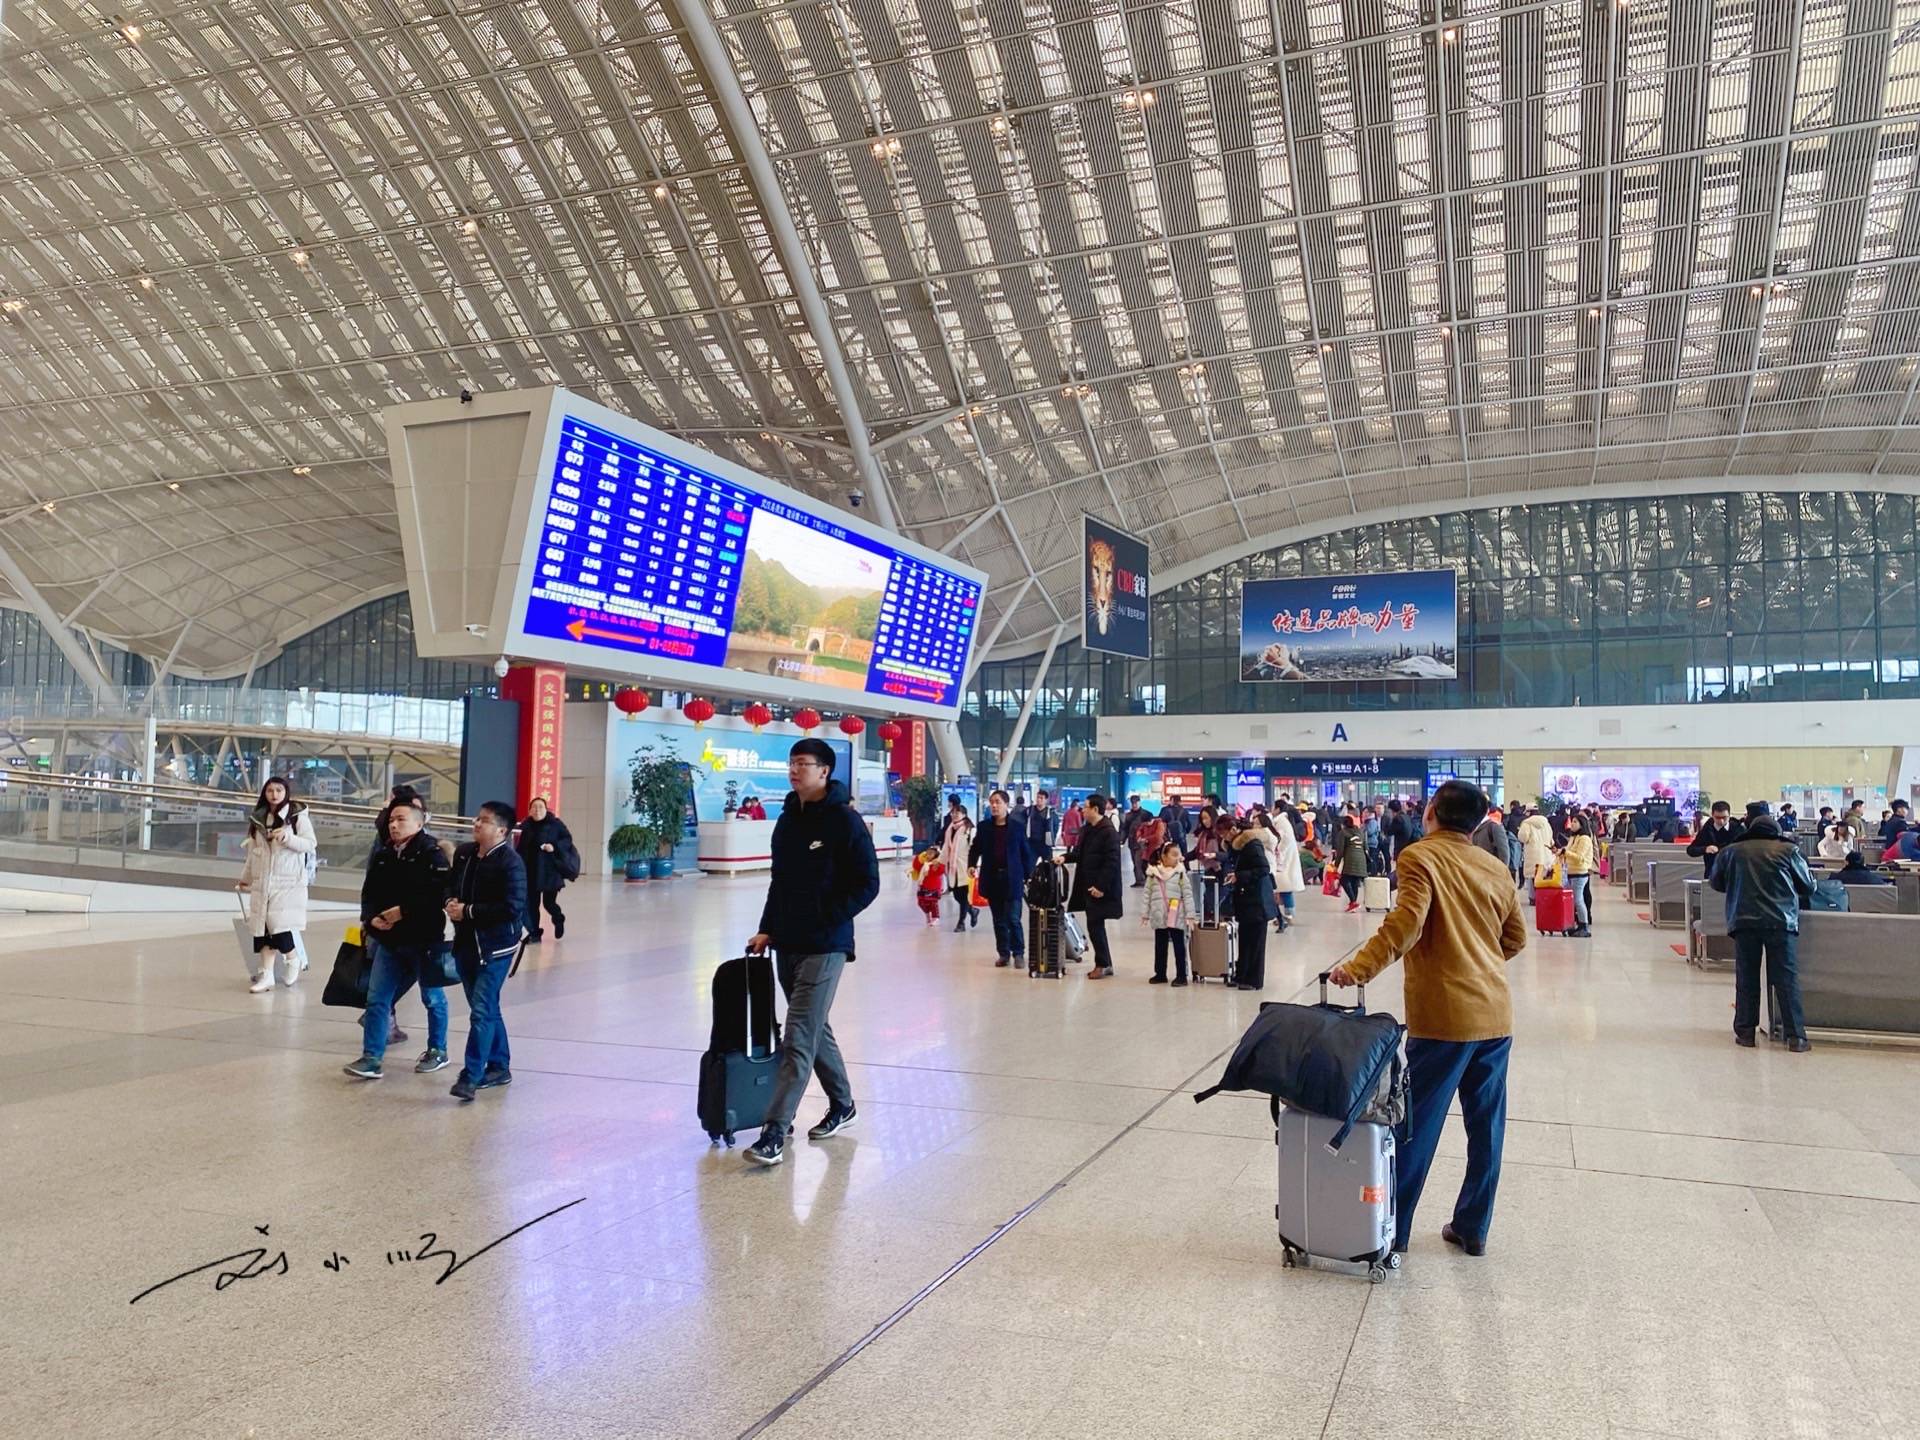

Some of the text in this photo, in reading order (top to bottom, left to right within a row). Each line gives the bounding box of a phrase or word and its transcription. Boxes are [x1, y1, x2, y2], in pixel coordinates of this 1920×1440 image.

[565, 450, 585, 466] G73
[562, 466, 581, 483] G82
[549, 531, 568, 546] G71
[1272, 600, 1420, 638] 传递品牌的力量
[1331, 722, 1348, 743] A
[1238, 773, 1247, 784] A
